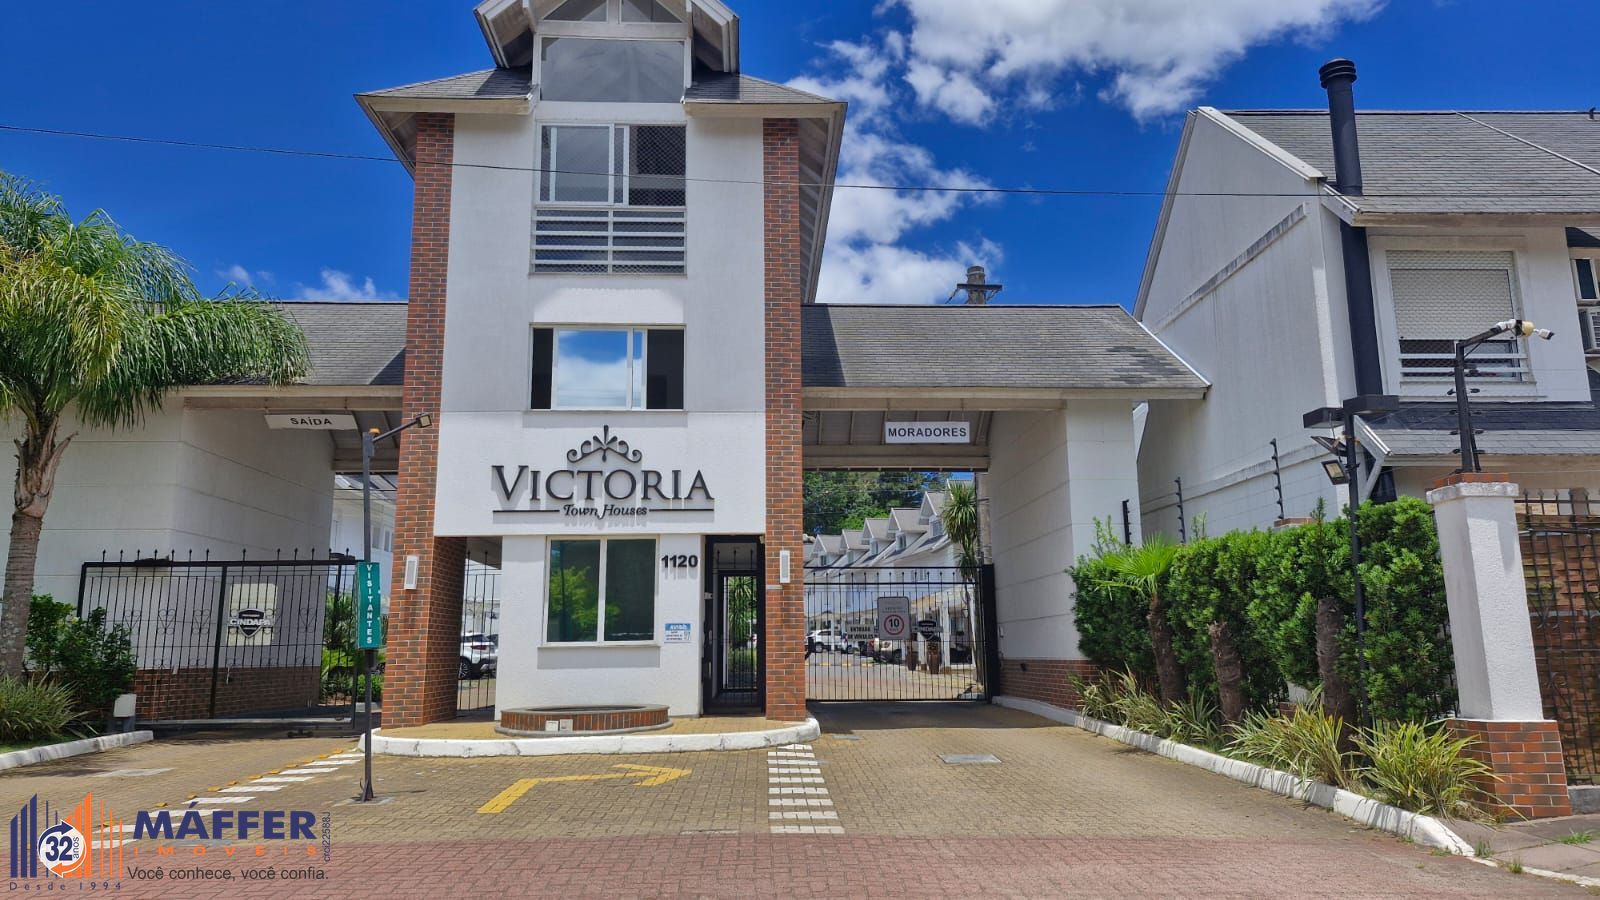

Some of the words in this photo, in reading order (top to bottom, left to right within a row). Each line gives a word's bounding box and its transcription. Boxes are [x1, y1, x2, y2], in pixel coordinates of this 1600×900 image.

[290, 416, 332, 426] SAÍDA
[888, 427, 967, 437] MORADORES
[563, 503, 600, 519] Town
[599, 504, 648, 520] Houses
[661, 554, 699, 569] 1120
[366, 564, 374, 645] VISITANTES
[888, 618, 900, 628] 10
